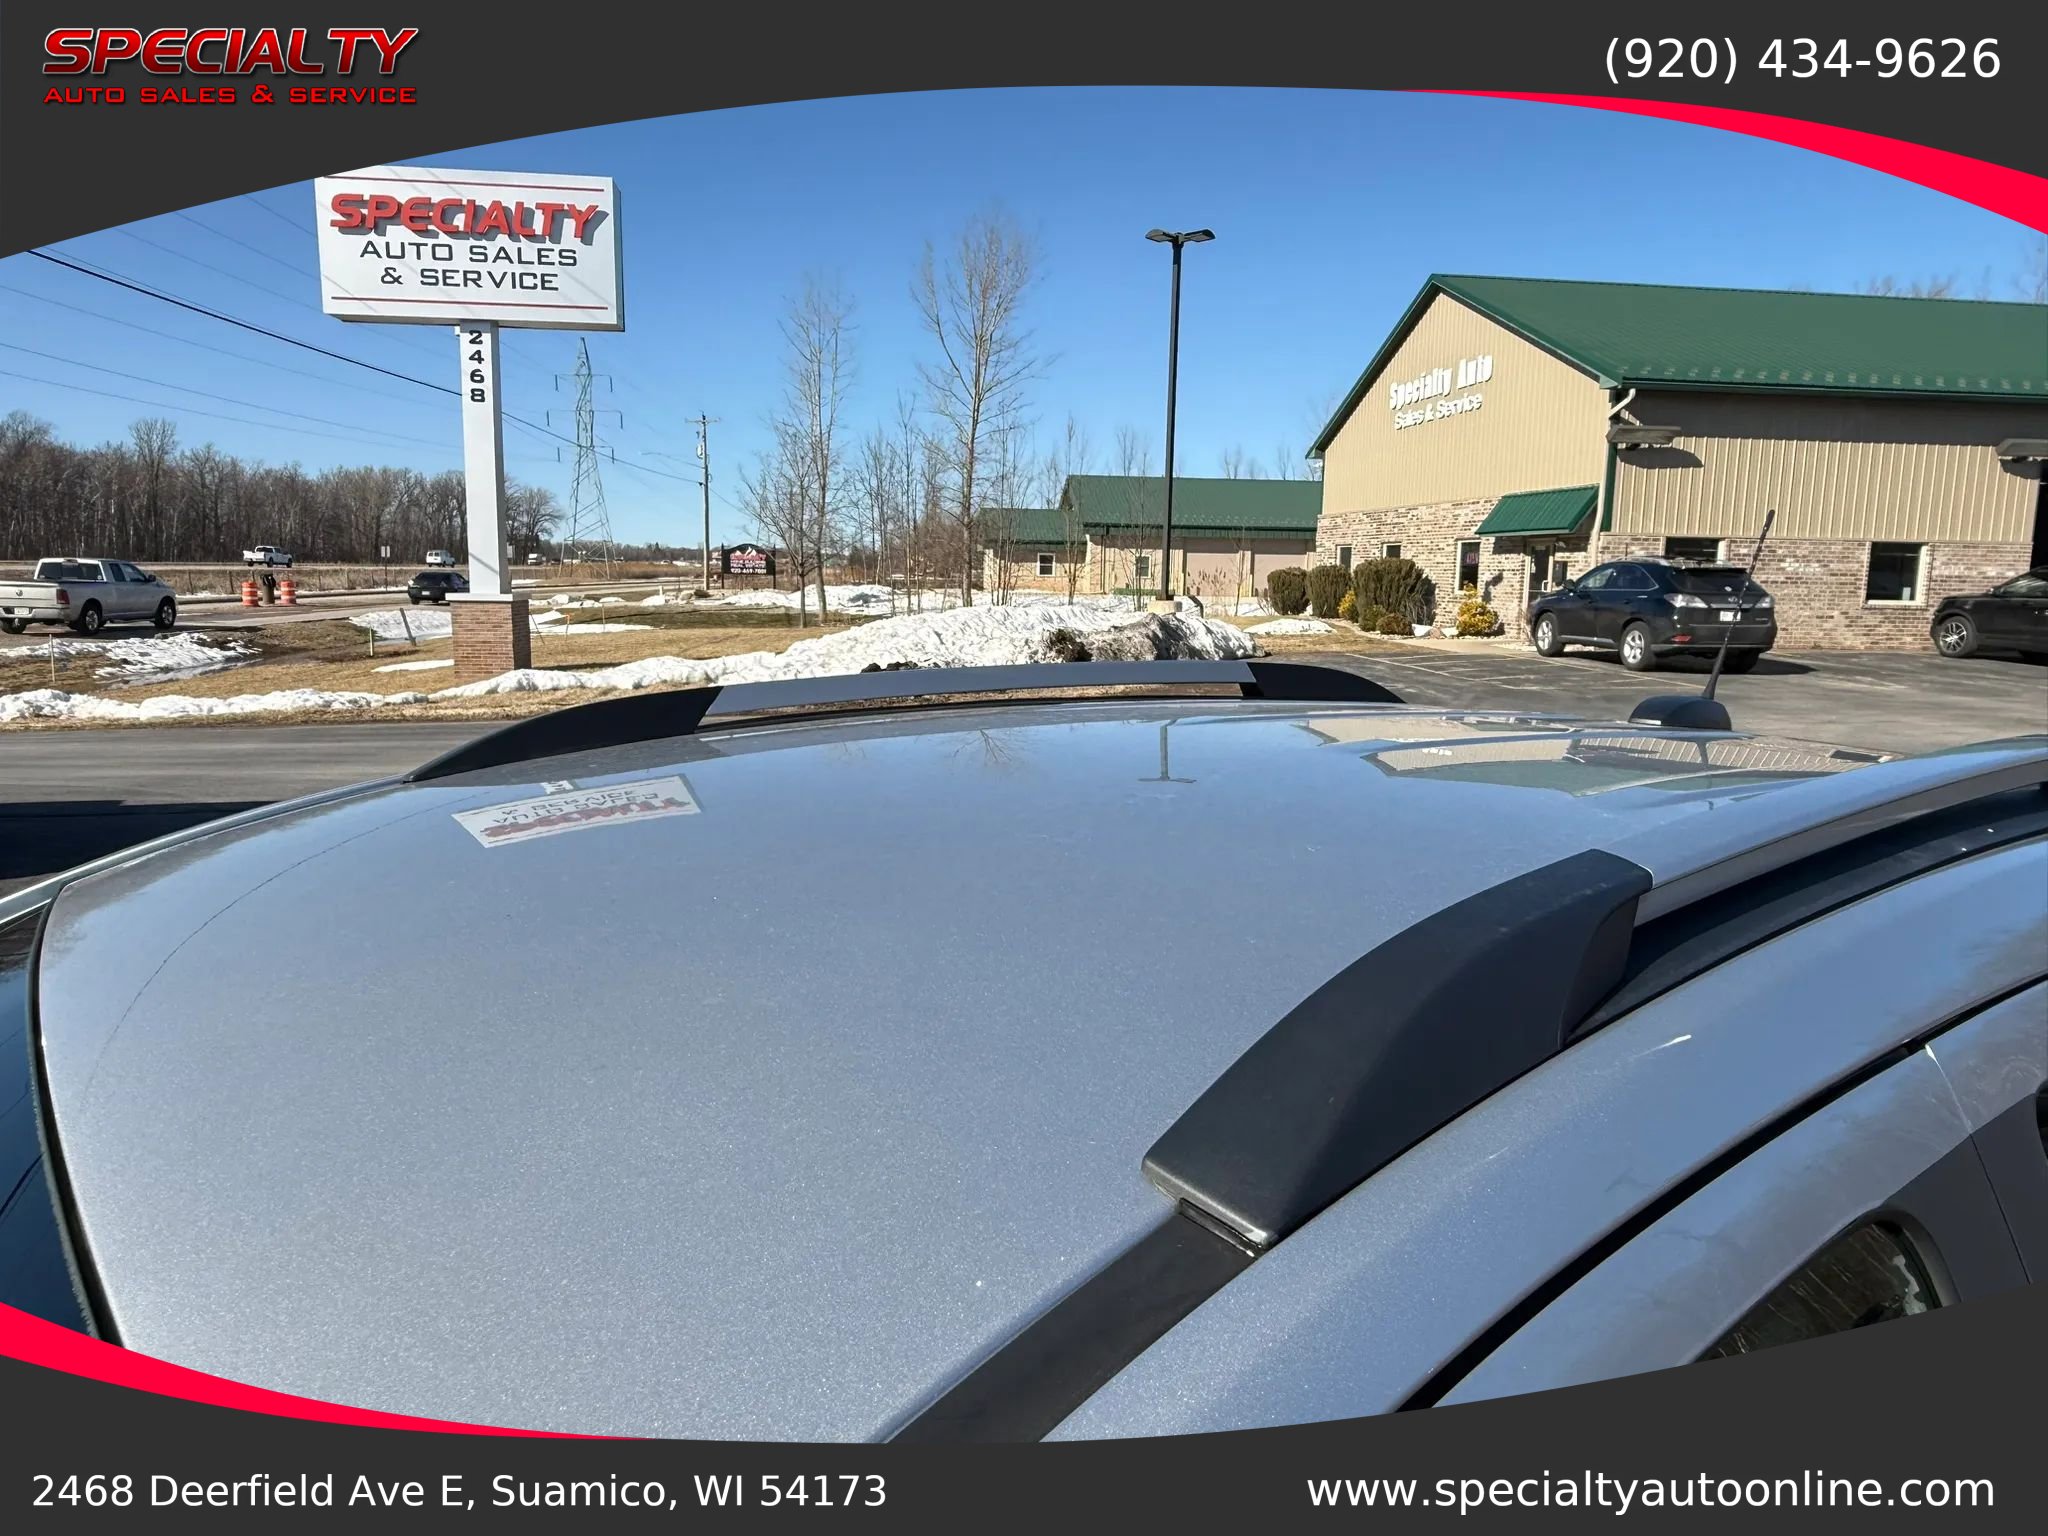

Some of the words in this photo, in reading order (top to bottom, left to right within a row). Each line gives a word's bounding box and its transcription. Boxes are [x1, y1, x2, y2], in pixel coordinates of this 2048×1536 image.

[330, 193, 600, 239] SPECIALTY
[360, 240, 453, 262] AUTO
[468, 244, 577, 267] SALES
[380, 266, 403, 285] &
[420, 268, 559, 291] SERVICE
[468, 329, 485, 403] 2468
[1390, 367, 1453, 410] Specialty
[1457, 353, 1493, 389] Auto
[1394, 408, 1424, 430] Sales
[1425, 403, 1435, 422] &
[1436, 393, 1483, 419] Service
